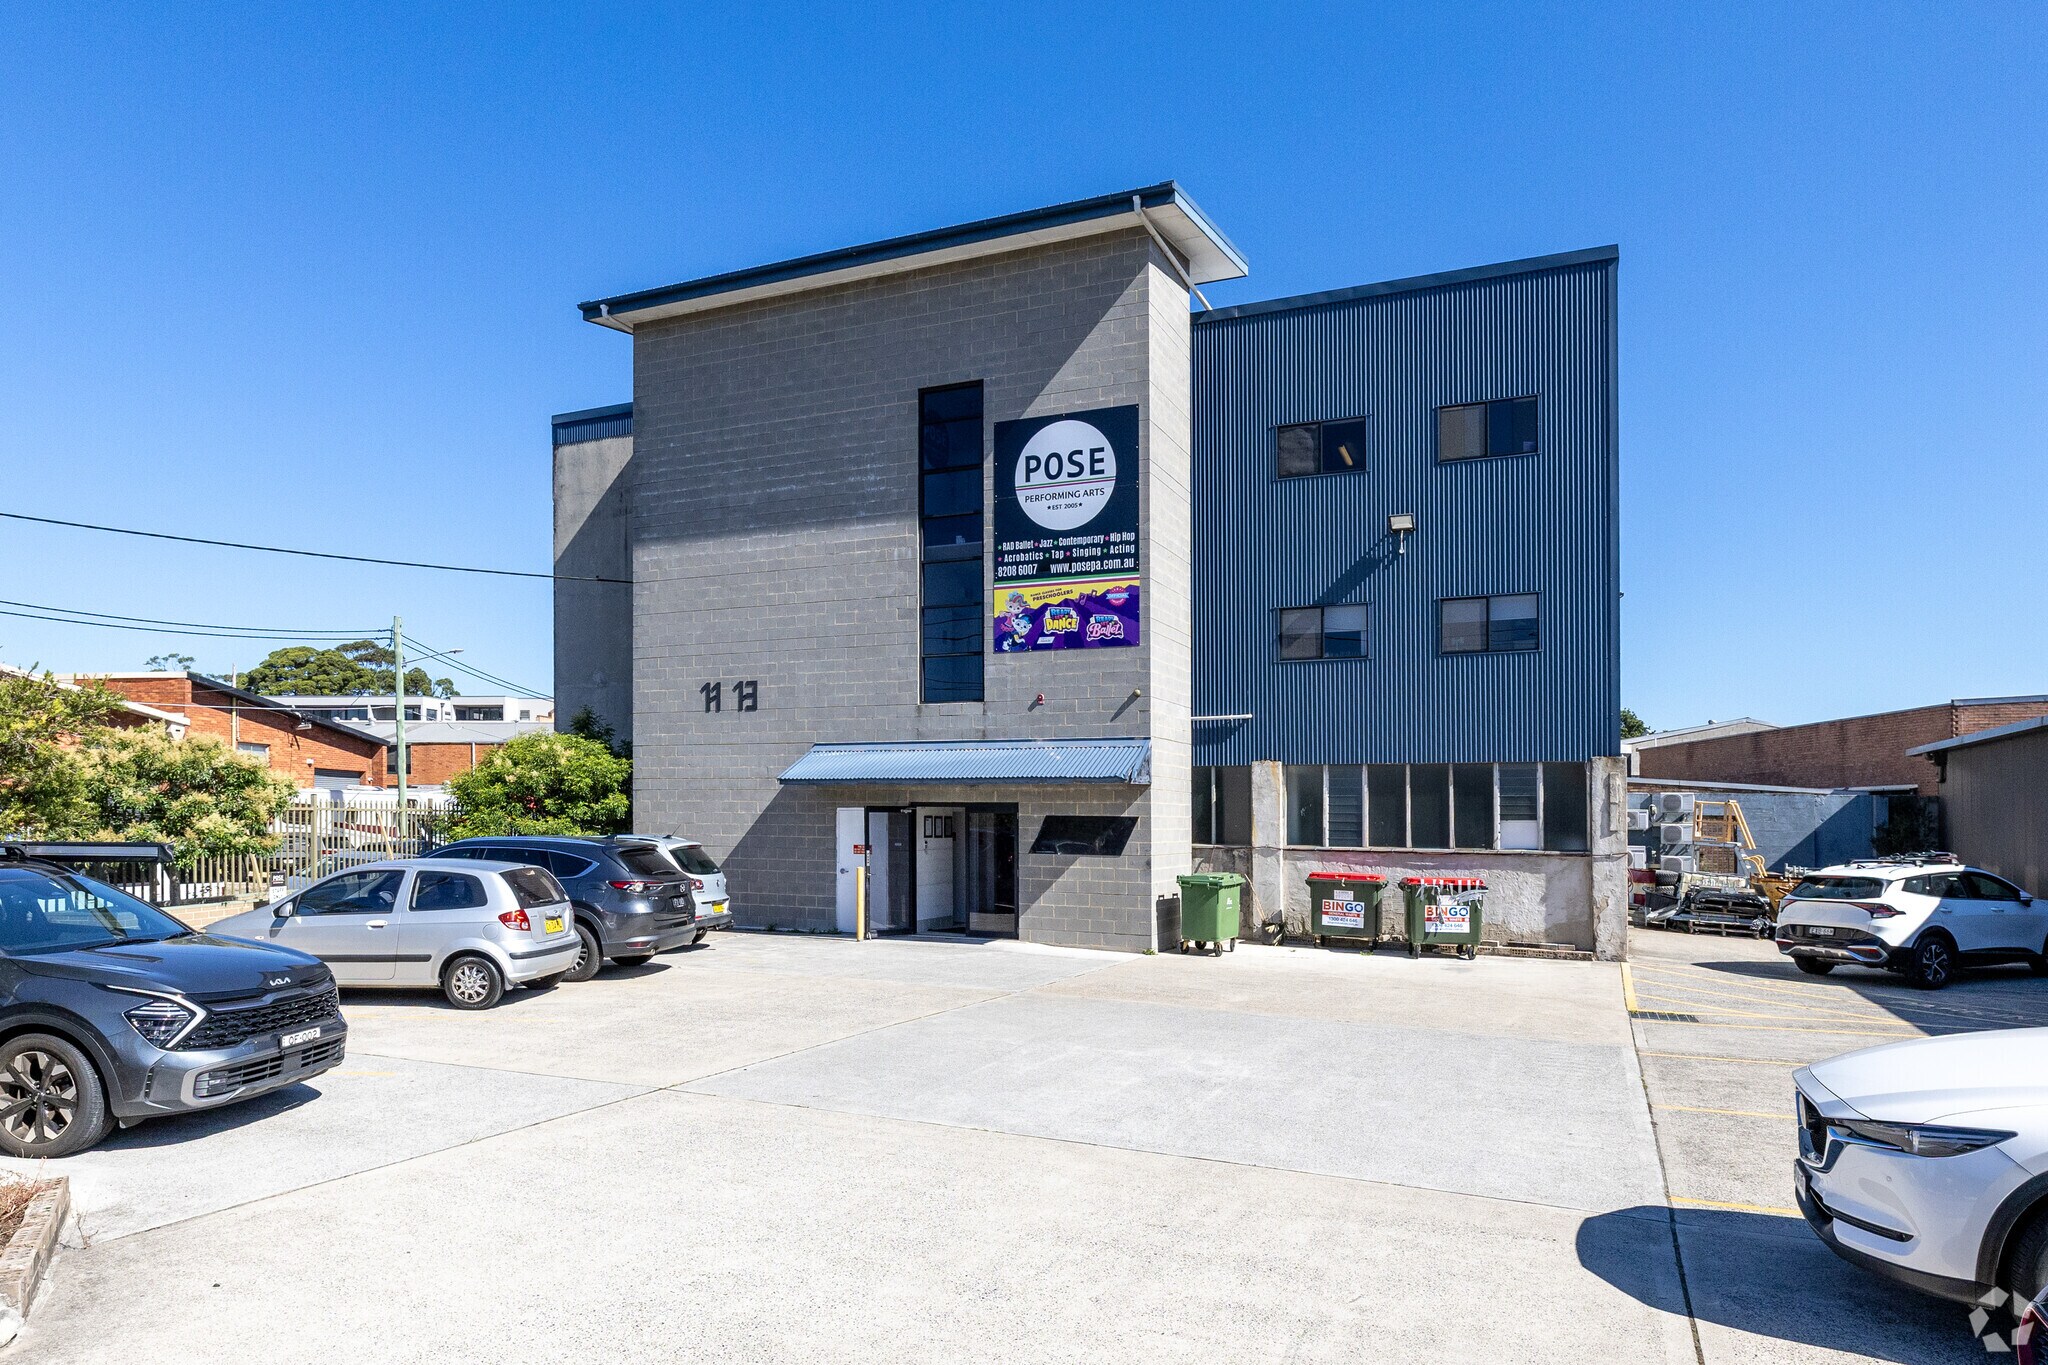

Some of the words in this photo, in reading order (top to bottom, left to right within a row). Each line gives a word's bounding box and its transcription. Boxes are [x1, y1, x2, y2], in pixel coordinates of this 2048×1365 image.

[1025, 447, 1105, 483] POSE
[1025, 490, 1081, 503] PERFORMING
[1083, 488, 1105, 497] ARTS
[1002, 541, 1015, 551] RAD
[1015, 540, 1034, 550] Ballet
[1039, 539, 1053, 548] Jazz
[1058, 534, 1104, 546] Contemporary
[1110, 532, 1121, 542] Hip
[1122, 531, 1135, 541] Hop
[1003, 552, 1044, 562] Acrobatics
[1051, 550, 1064, 559] Tap
[1072, 547, 1101, 558] Singing
[1110, 543, 1135, 554] Acting
[998, 565, 1017, 577] 8208
[1018, 563, 1038, 576] 6007
[1050, 557, 1135, 574] www.posepa.com.au
[1032, 589, 1074, 602] PRESCHOOLERS
[1050, 608, 1071, 616] READY
[1045, 618, 1078, 631] DANCE
[1089, 622, 1121, 637] Ballet
[699, 681, 721, 713] 11
[731, 680, 758, 712] 13
[1323, 900, 1364, 912] BINGO
[1426, 906, 1469, 917] BINGO
